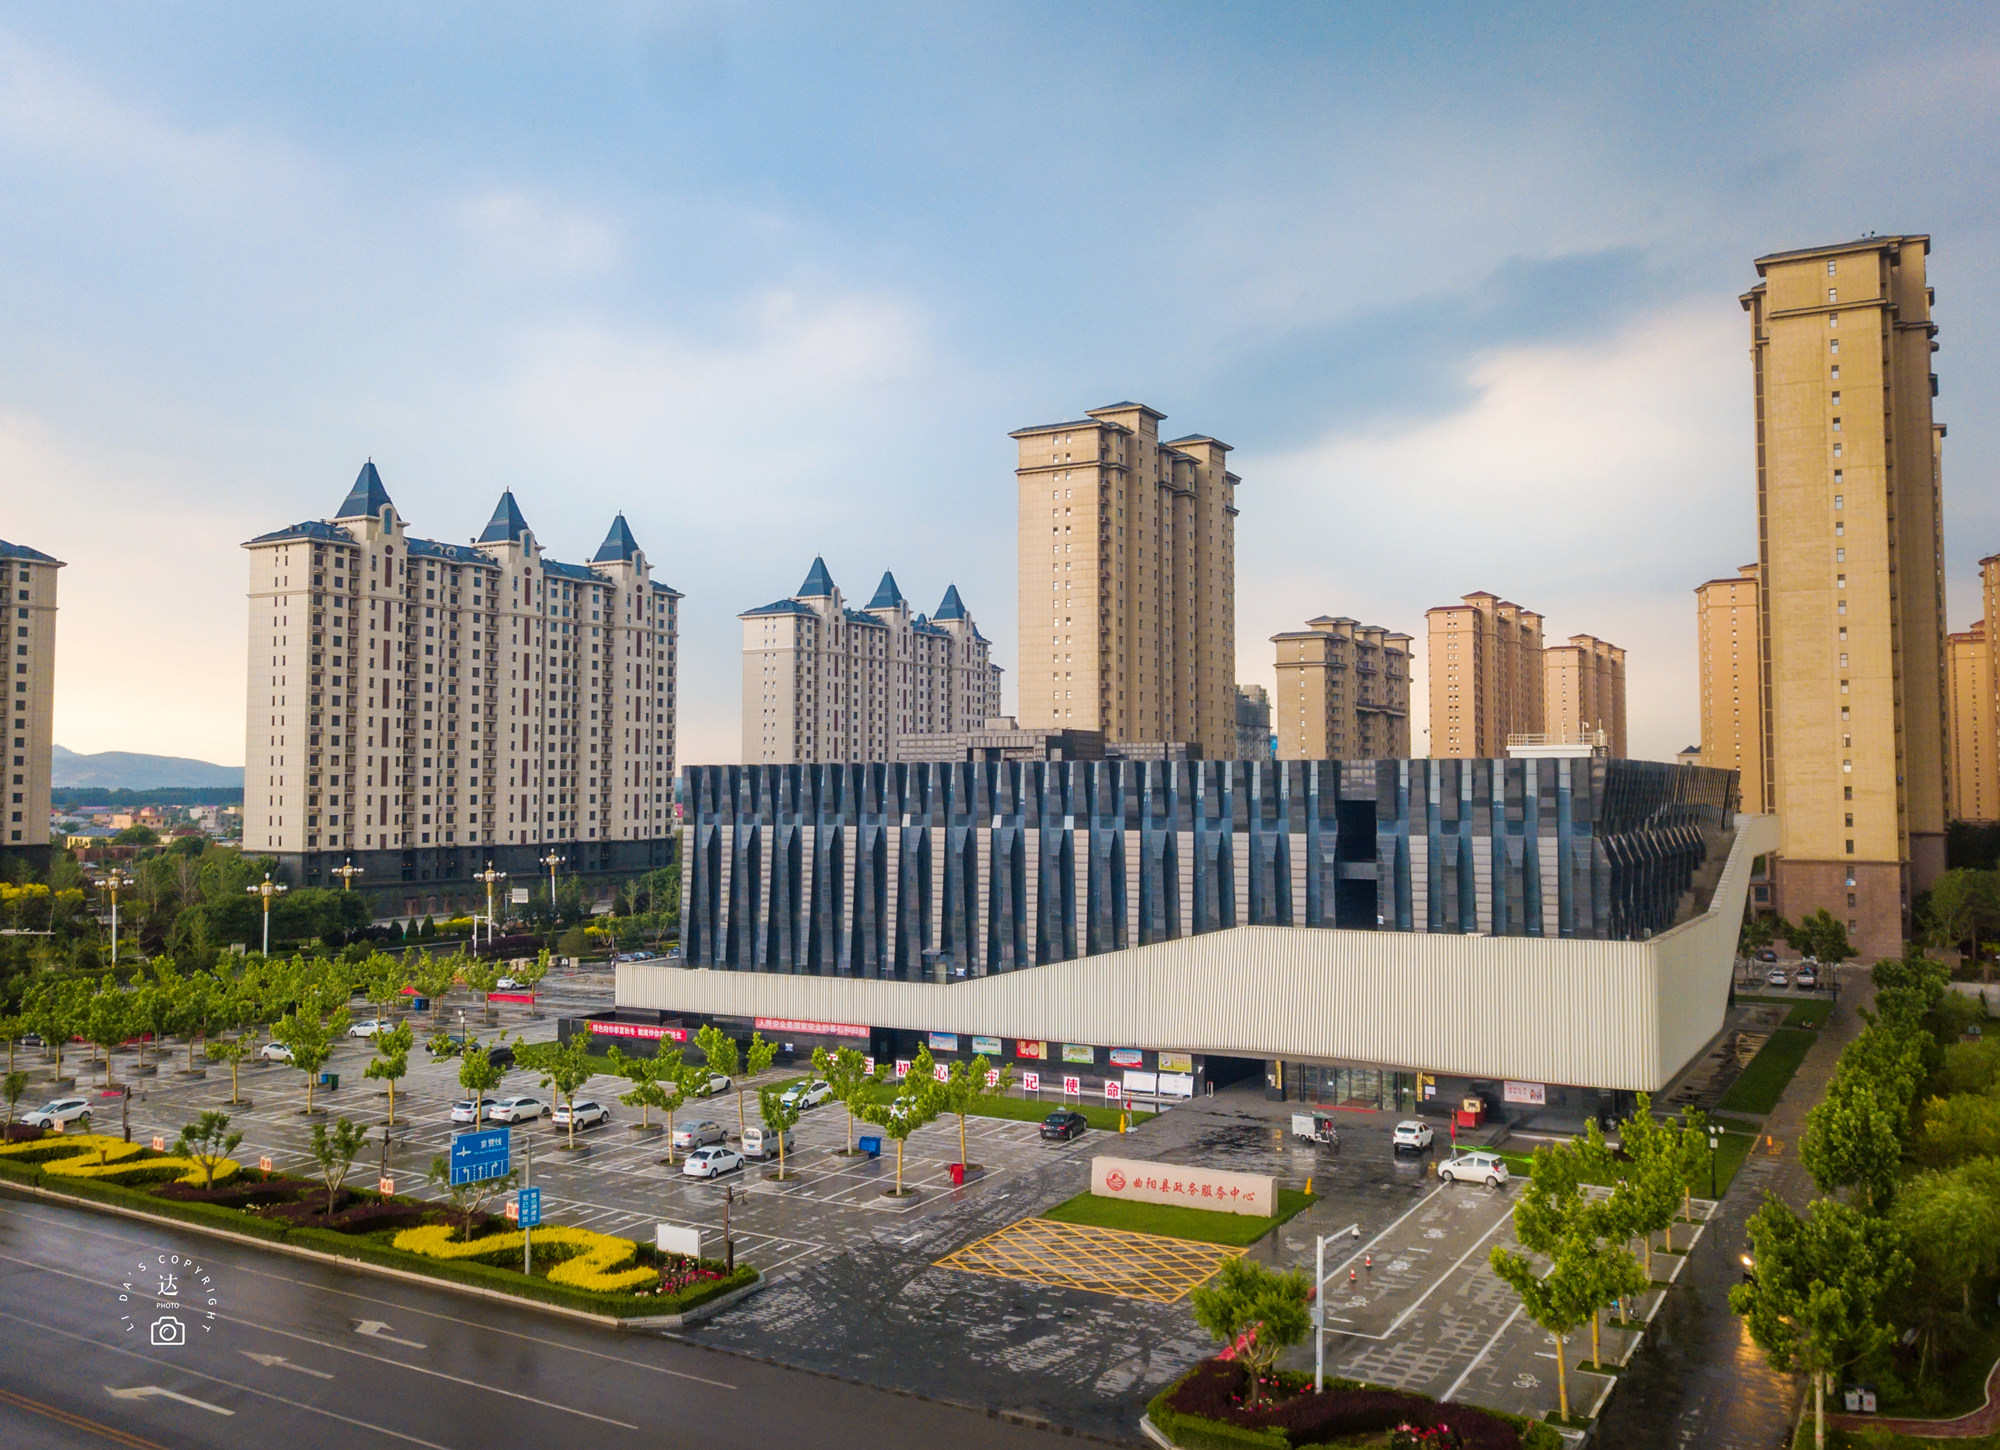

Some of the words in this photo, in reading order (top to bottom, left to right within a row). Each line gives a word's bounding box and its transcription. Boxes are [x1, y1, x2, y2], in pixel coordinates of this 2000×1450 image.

[758, 1020, 867, 1035] 人民安全是国家安全的基石和归宿
[1132, 1177, 1256, 1202] 曲阳县政务服务中心
